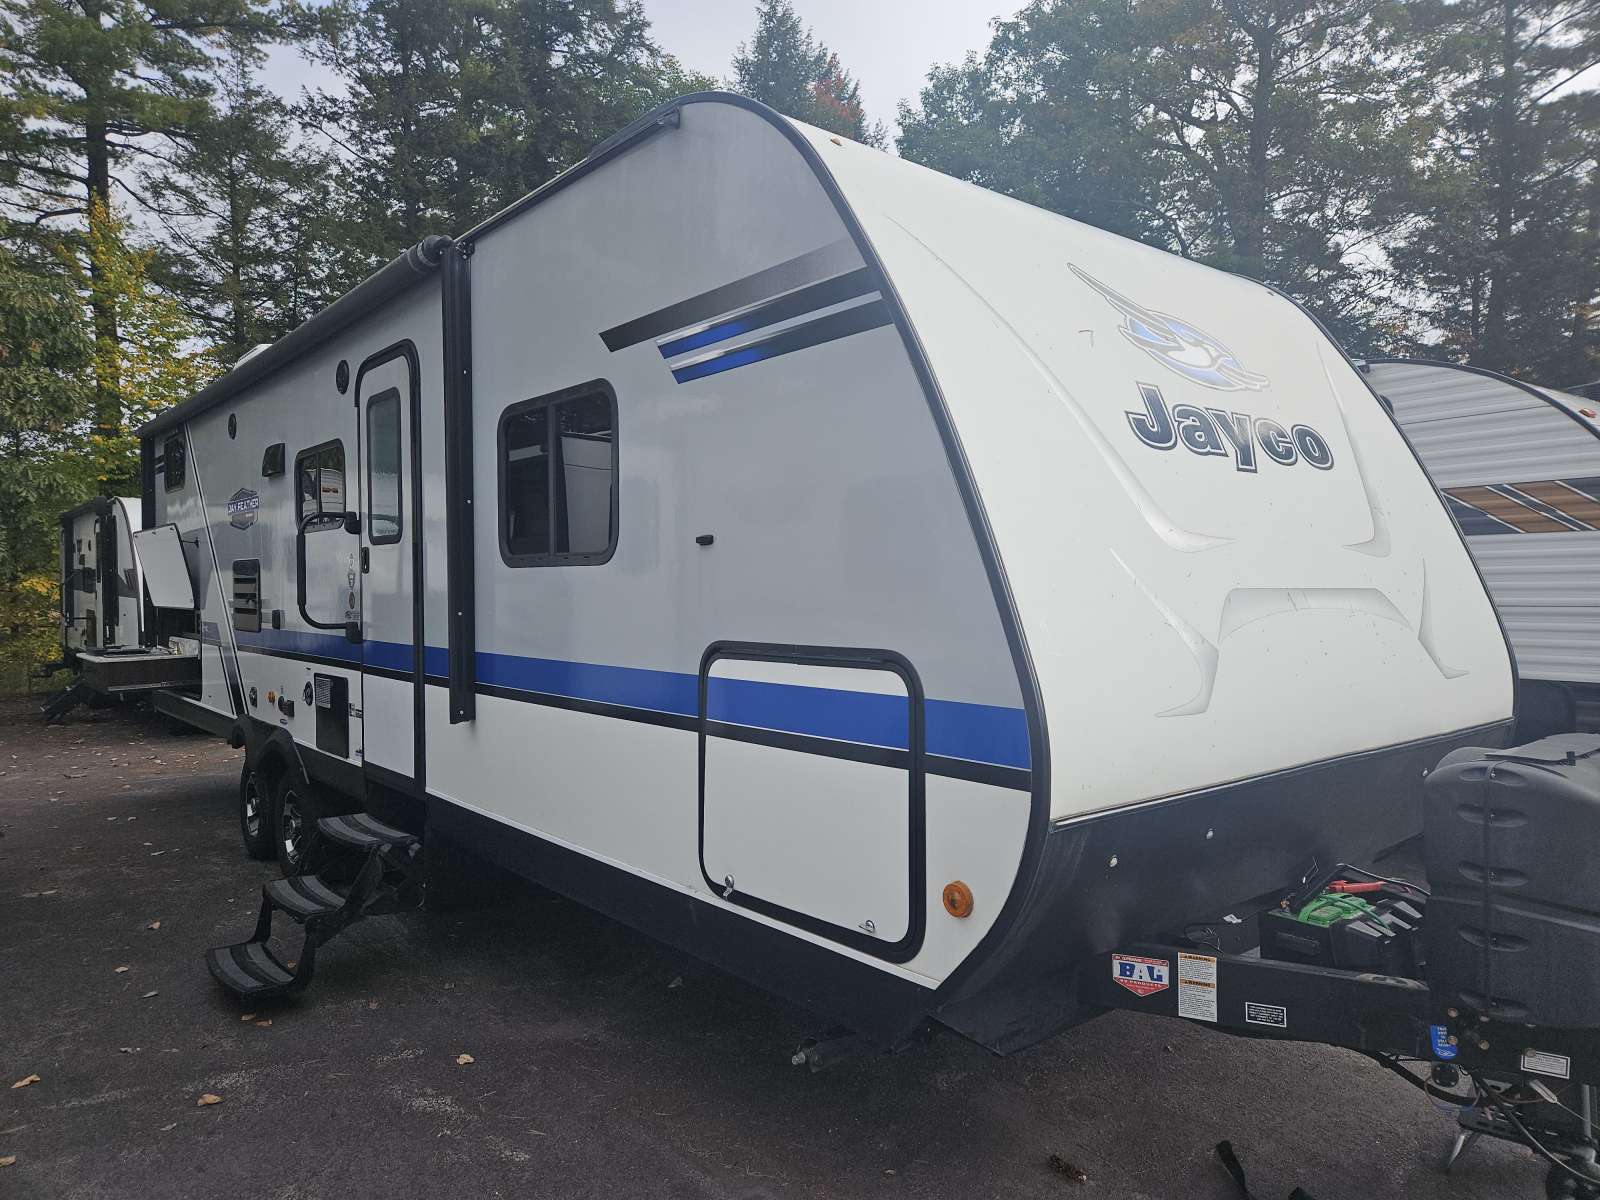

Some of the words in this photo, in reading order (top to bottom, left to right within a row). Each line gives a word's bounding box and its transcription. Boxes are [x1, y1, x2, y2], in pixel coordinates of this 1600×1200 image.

[1124, 381, 1334, 473] Jayco
[228, 504, 237, 513] JAY
[237, 498, 258, 510] FEATHER
